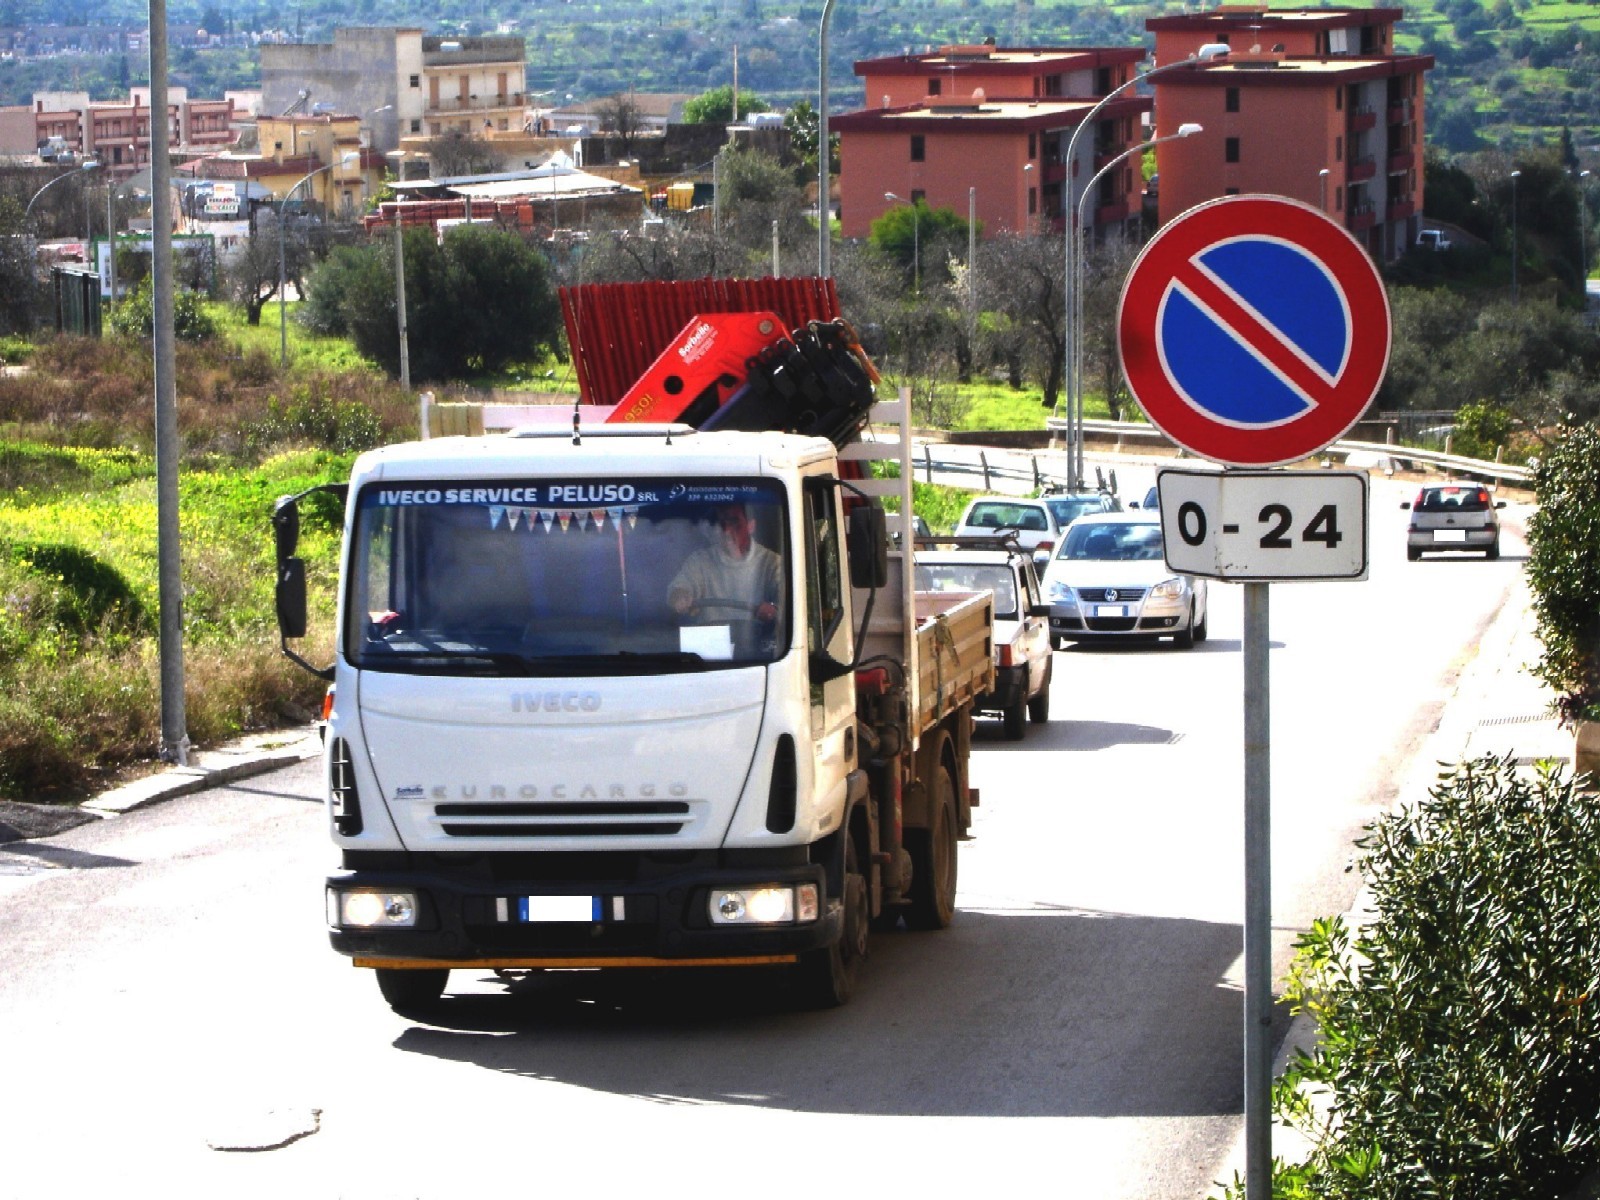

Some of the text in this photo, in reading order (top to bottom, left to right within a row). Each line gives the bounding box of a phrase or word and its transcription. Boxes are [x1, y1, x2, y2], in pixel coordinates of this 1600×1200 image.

[379, 484, 660, 505] IVECO SERVICE PELUSO SRL
[1178, 501, 1207, 546] 0
[1258, 503, 1343, 548] 24
[510, 690, 602, 713] IVECO
[430, 781, 689, 800] EUROCARGO
